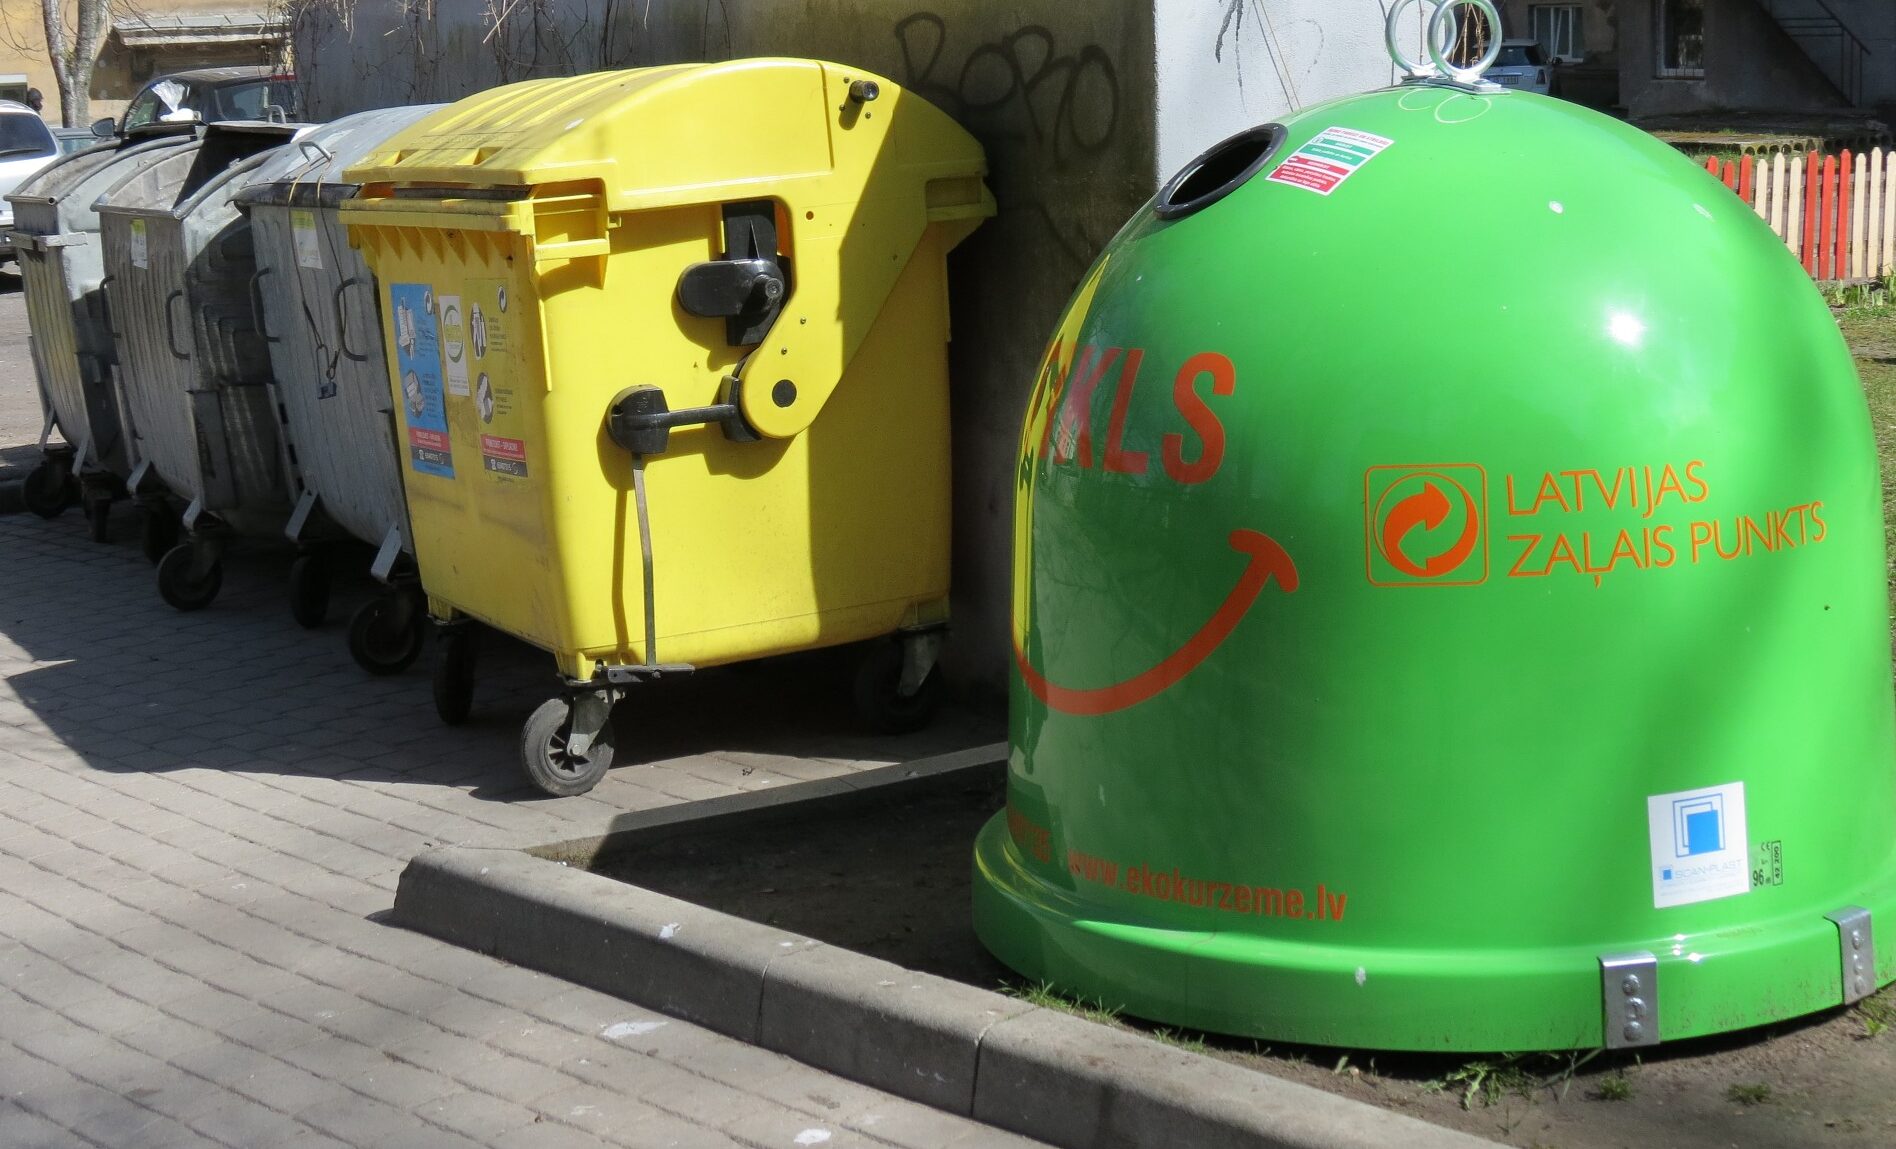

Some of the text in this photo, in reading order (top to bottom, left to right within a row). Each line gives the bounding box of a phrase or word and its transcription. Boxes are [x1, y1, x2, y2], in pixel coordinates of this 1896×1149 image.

[1506, 460, 1709, 518] LATVIJAS
[1507, 501, 1827, 588] ZAĻAIS PUNKTS
[1067, 849, 1347, 922] www.ekokurzeme.lv
[1752, 869, 1764, 886] 96
